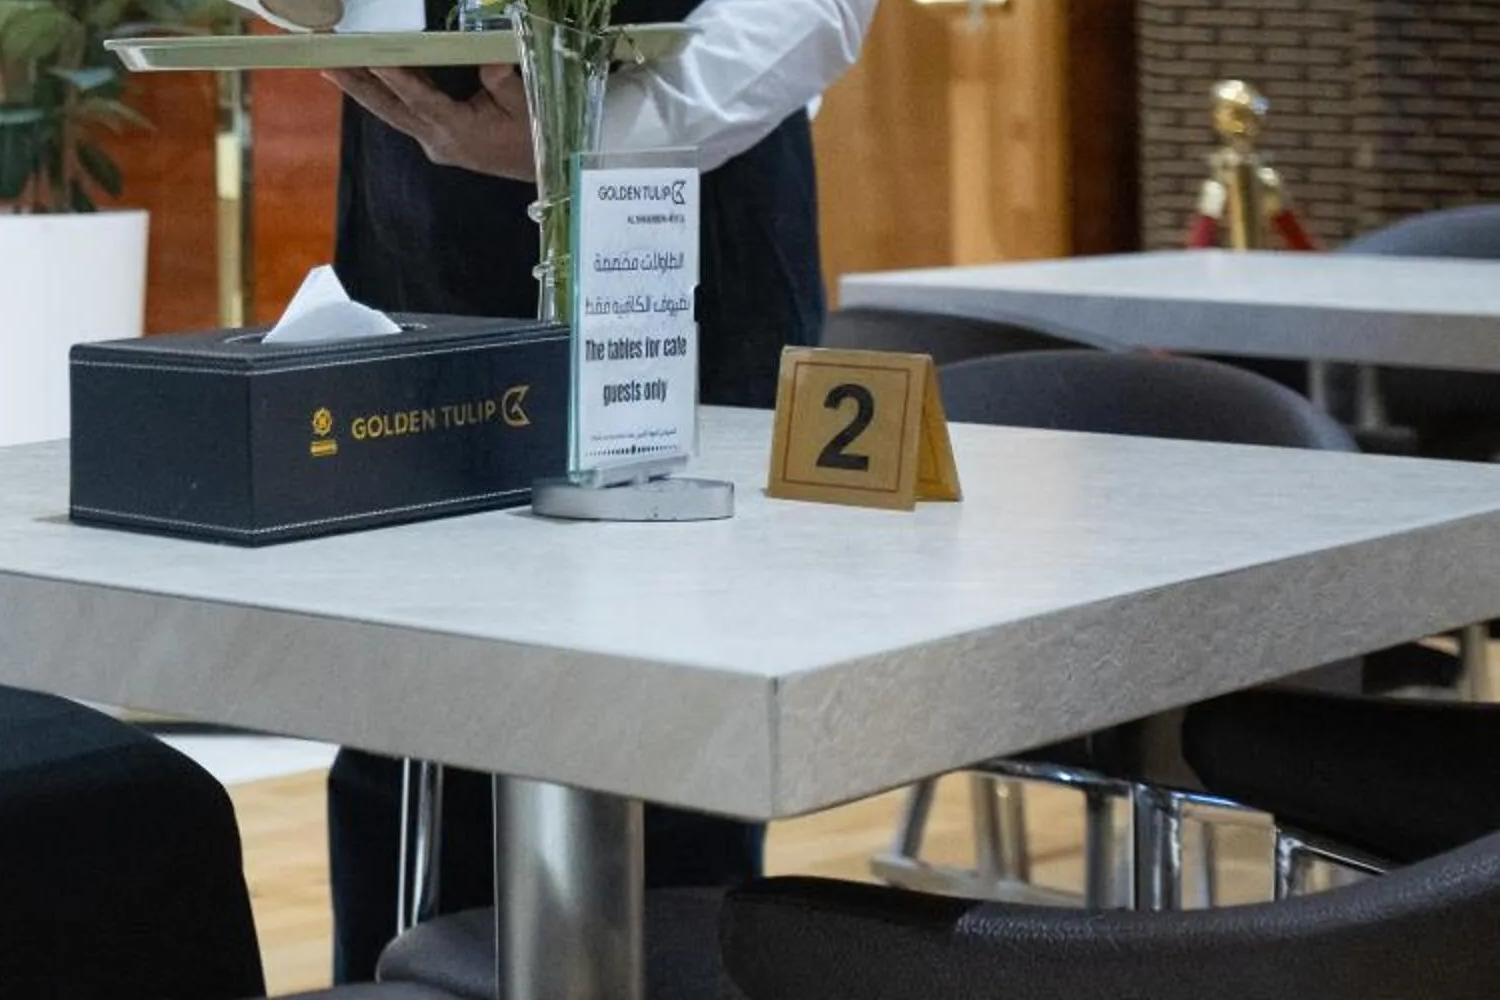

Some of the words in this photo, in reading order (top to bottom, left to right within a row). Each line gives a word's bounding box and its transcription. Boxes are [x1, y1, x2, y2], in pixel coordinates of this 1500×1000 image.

[598, 185, 641, 201] GOLDEN
[642, 184, 671, 201] TULIP
[585, 338, 605, 361] The
[607, 337, 643, 360] tables
[645, 336, 661, 359] for
[663, 335, 687, 357] cafe
[603, 380, 642, 407] guests
[643, 378, 668, 403] only
[351, 406, 436, 440] GOLDEN
[441, 400, 497, 427] TULIP
[816, 383, 875, 472] 2
